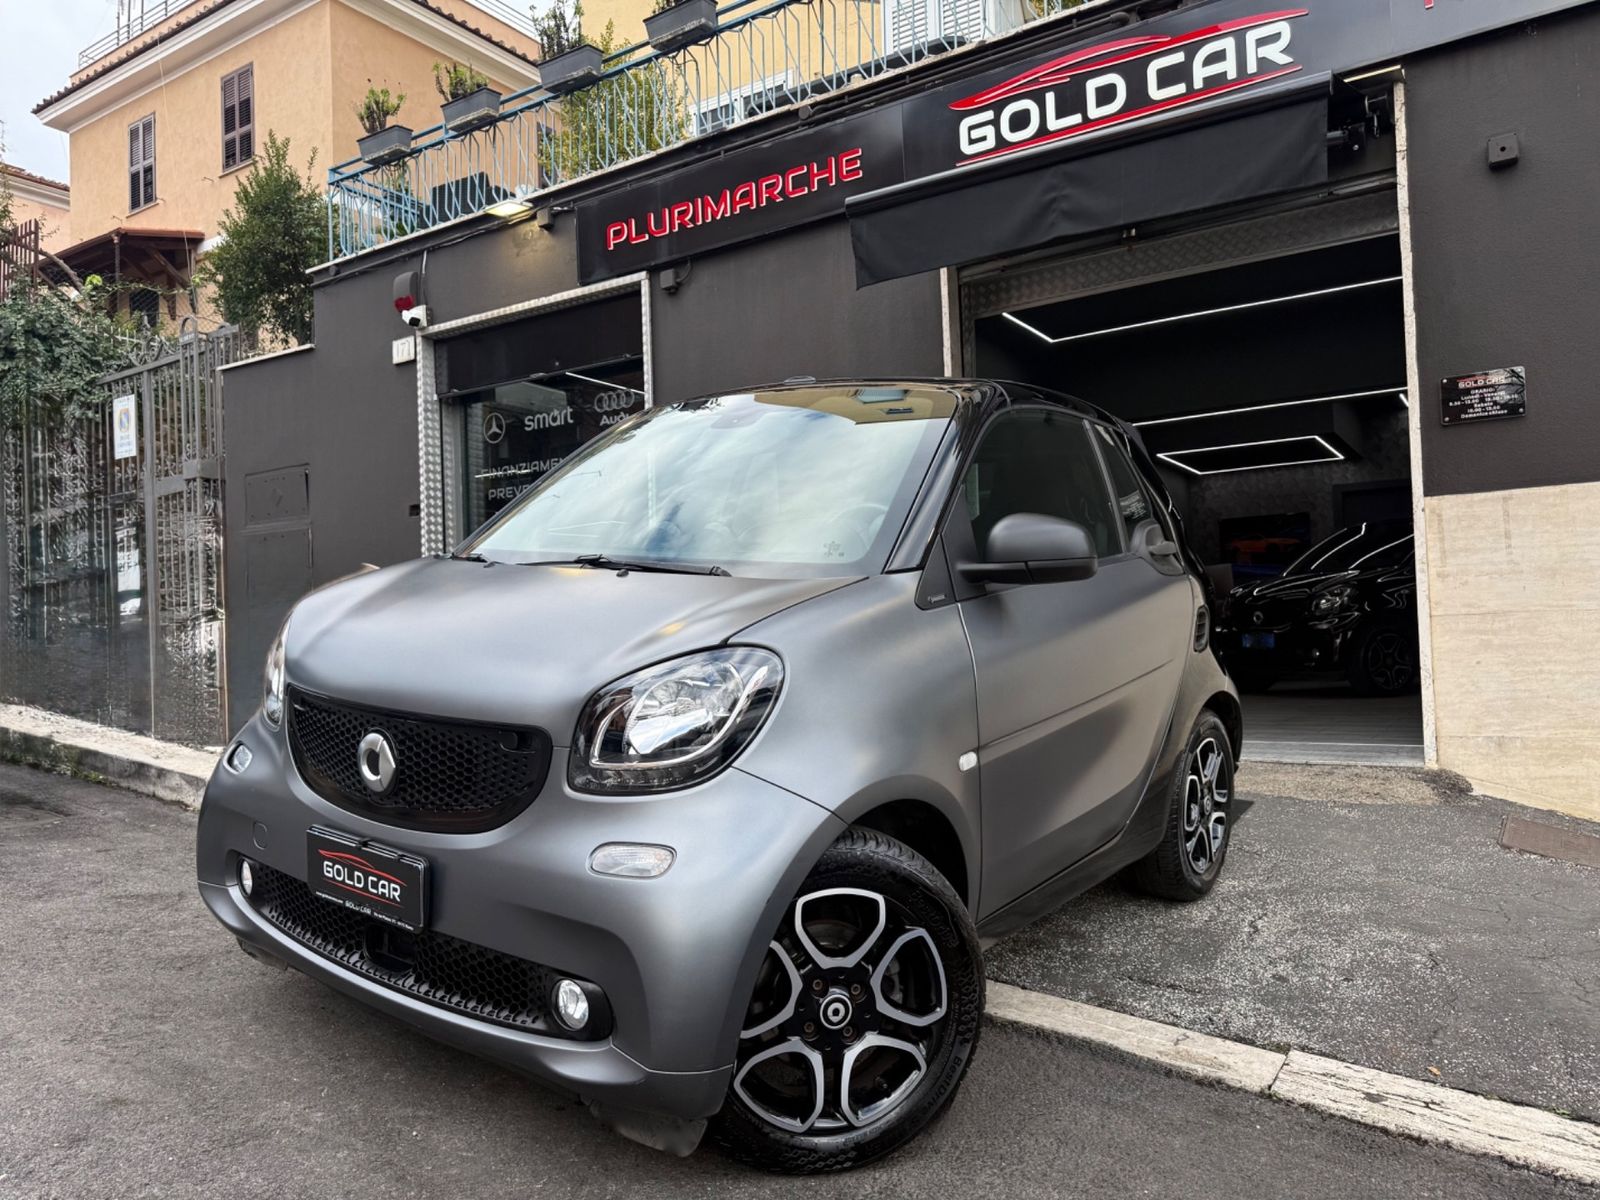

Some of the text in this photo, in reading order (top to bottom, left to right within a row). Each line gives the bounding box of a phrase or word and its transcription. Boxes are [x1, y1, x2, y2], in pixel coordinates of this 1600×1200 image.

[959, 20, 1295, 156] GOLD CAR
[607, 148, 863, 251] PLURIMARCHE
[524, 406, 574, 431] smart
[323, 860, 364, 888] GOLD
[367, 876, 401, 902] CAR
